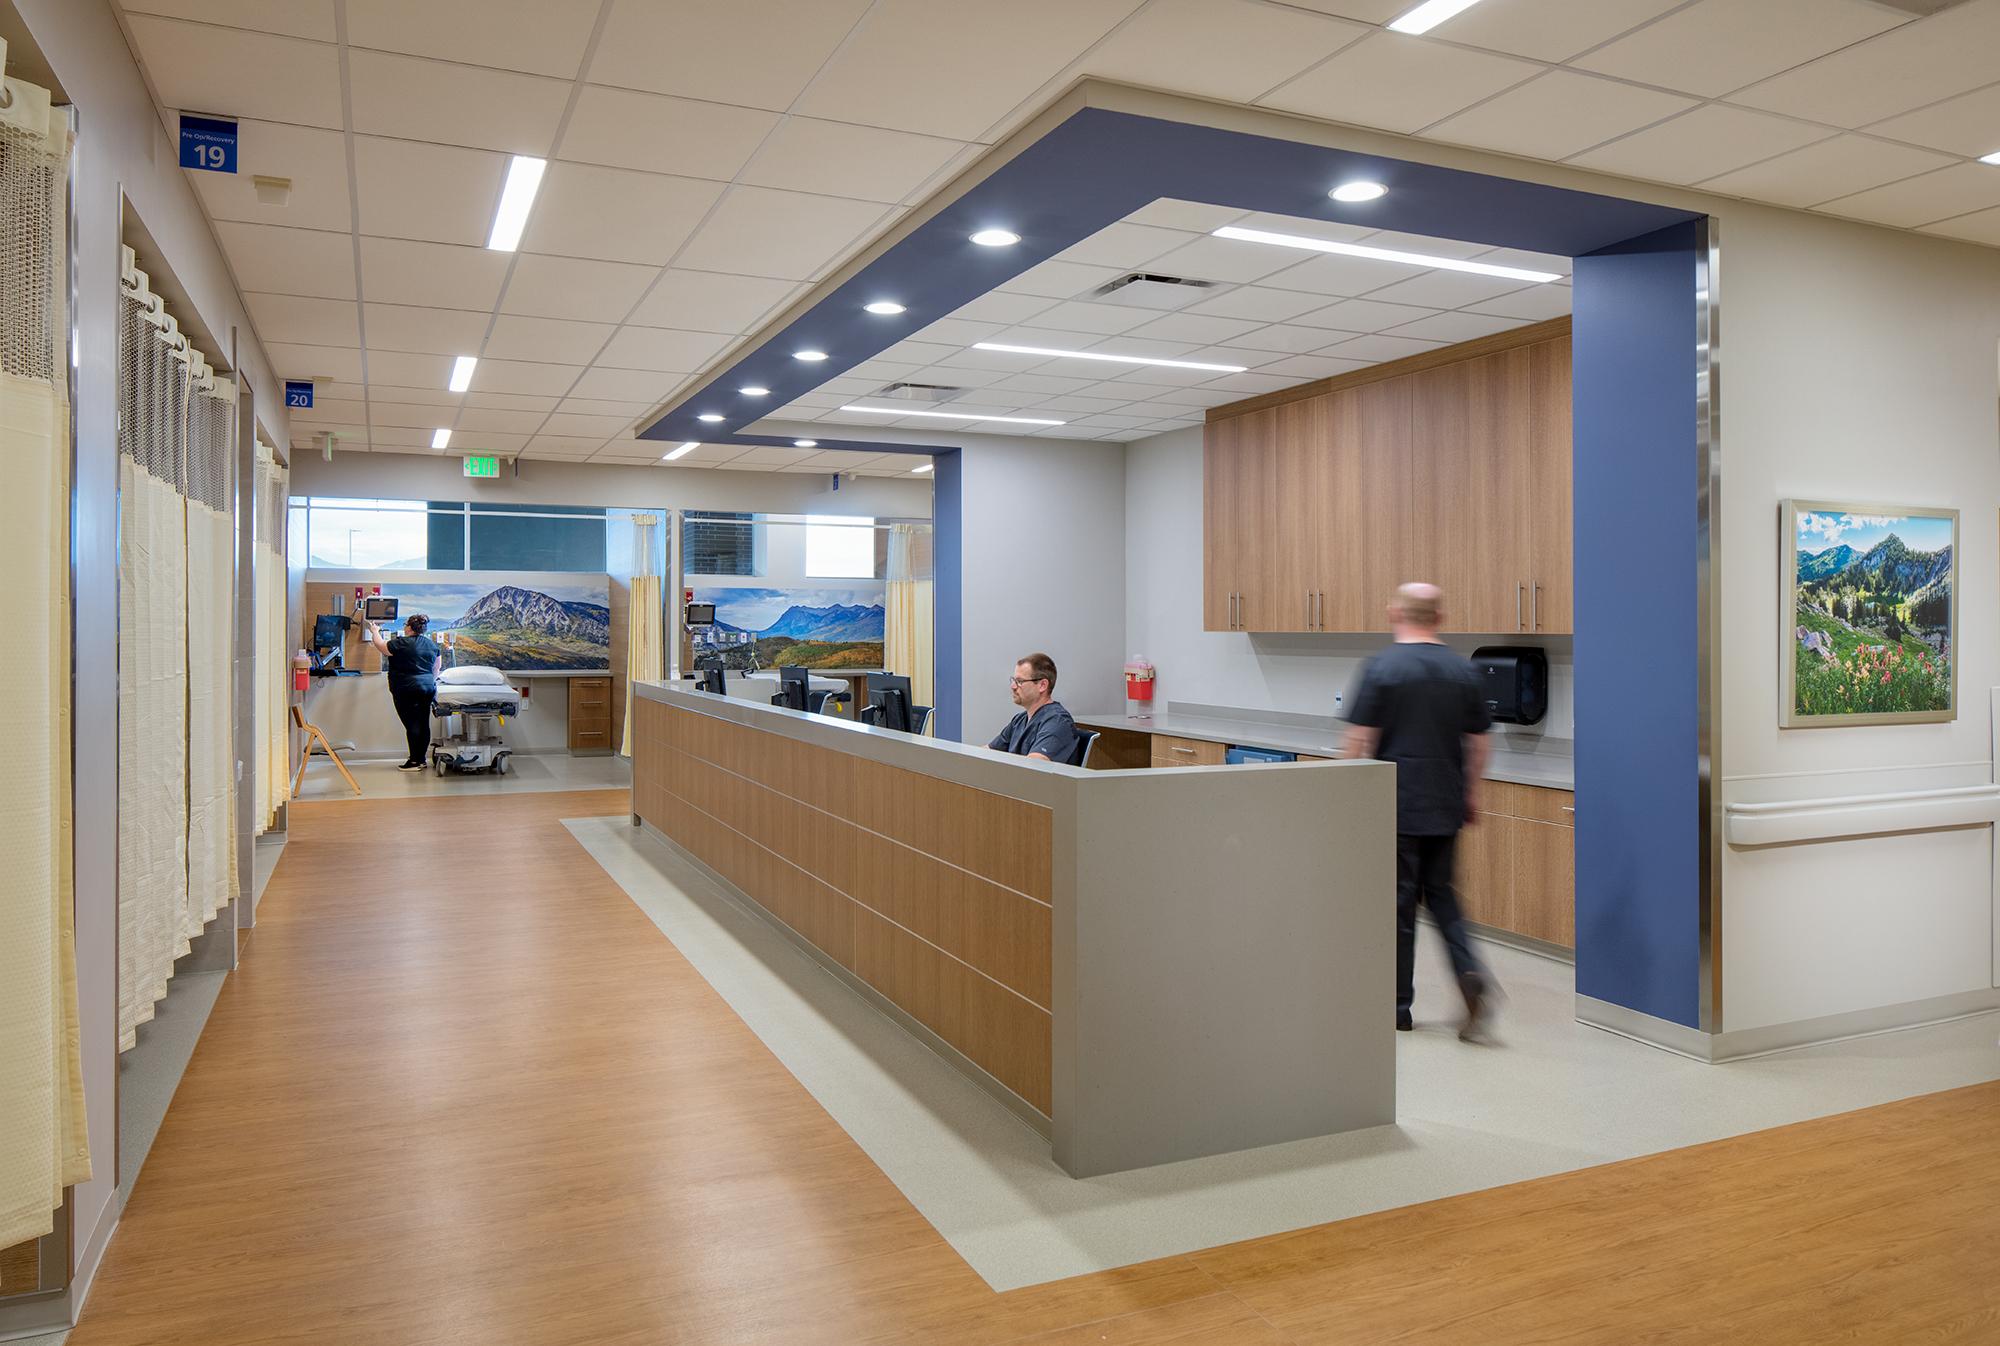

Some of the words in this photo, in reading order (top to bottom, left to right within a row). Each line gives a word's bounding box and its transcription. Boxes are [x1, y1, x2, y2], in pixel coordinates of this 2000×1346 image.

[194, 145, 225, 168] 19
[290, 394, 308, 406] 20
[470, 457, 495, 476] EXIT
